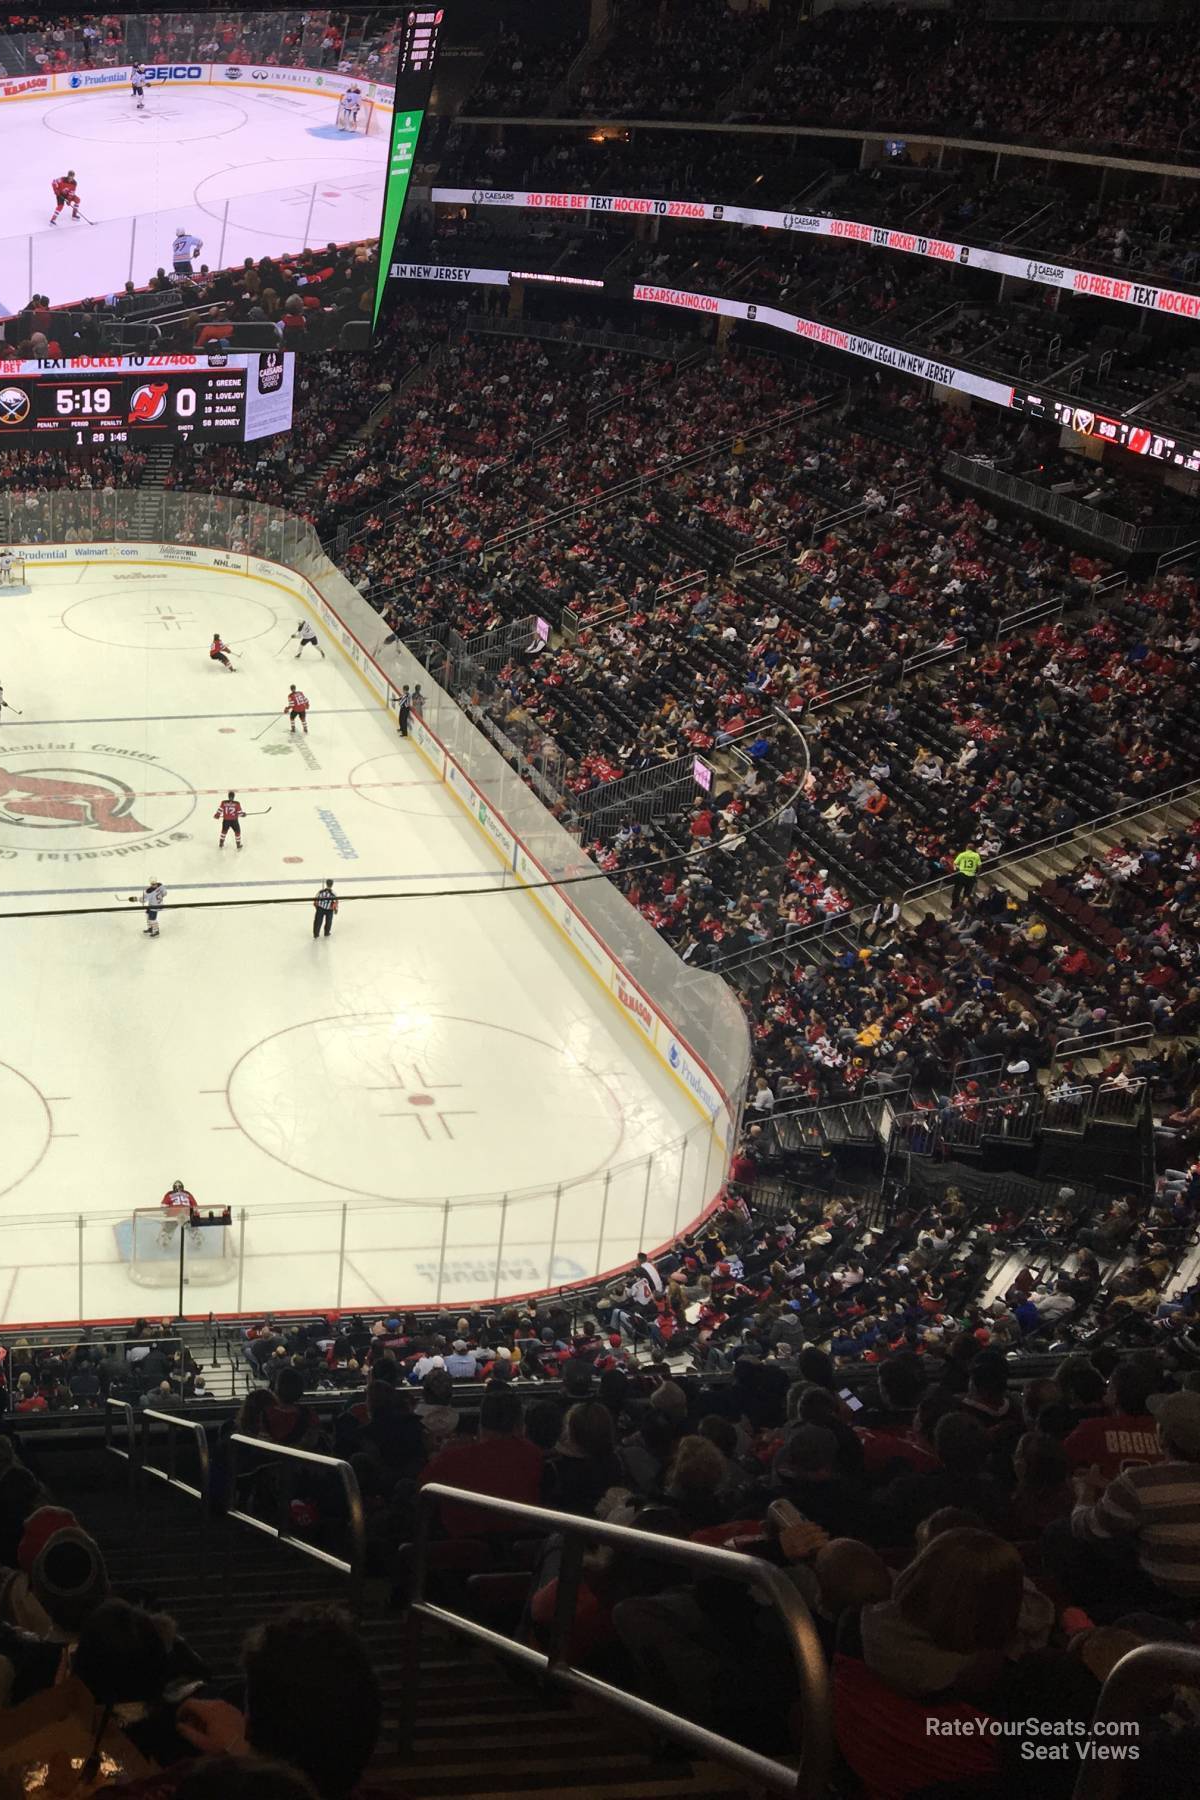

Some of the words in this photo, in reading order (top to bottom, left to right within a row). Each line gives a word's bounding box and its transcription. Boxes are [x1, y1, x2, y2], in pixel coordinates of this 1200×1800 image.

[84, 72, 127, 85] Prudential
[145, 66, 202, 80] GEICO
[485, 192, 514, 200] CAESARS
[527, 194, 542, 206] $10
[544, 195, 568, 207] FREE
[570, 195, 588, 208] BET
[590, 197, 612, 209] TEXT
[613, 198, 652, 212] HOCKEY
[654, 201, 666, 214] TO
[669, 203, 704, 217] 227466
[794, 217, 820, 227] CAESARS
[844, 223, 861, 239] FREE
[860, 226, 873, 241] BET
[873, 229, 889, 244] TEXT
[889, 231, 916, 249] HOCKEY
[917, 239, 927, 253] TO
[927, 241, 955, 260] 227466
[396, 265, 406, 276] IN
[410, 266, 431, 277] NEW
[434, 268, 470, 281] JERSEY
[1038, 265, 1064, 280] CAESARS
[635, 286, 718, 312] AESARSCASINO.COM
[1089, 276, 1112, 298] FREE
[1112, 281, 1131, 300] BET
[1132, 285, 1158, 306] TEXT
[1158, 291, 1200, 317] HOCKEY
[797, 319, 820, 339] SPORTS
[821, 327, 849, 348] BETTING
[849, 337, 856, 351] IS
[858, 341, 874, 355] NOW
[874, 345, 896, 364] LEGAL
[900, 352, 906, 367] IN
[907, 355, 925, 372] NEW
[925, 362, 955, 385] JERSEY
[3, 364, 22, 374] BET
[37, 357, 66, 369] TEXT
[128, 357, 144, 367] TO
[216, 379, 241, 387] GREENE
[56, 388, 110, 414] 5:19
[176, 388, 196, 417] 0
[215, 391, 244, 400] LOVEJOY
[215, 405, 236, 413] ZAJAC
[37, 421, 59, 429] PENALTY
[214, 418, 240, 427] ROONEY
[76, 431, 83, 445] 1
[110, 432, 127, 441] 1:45
[183, 432, 188, 441] 7
[16, 550, 67, 560] Prudential
[74, 548, 108, 556] Walmart
[90, 743, 161, 761] Center
[36, 838, 171, 862] Prudential
[963, 859, 974, 869] 13
